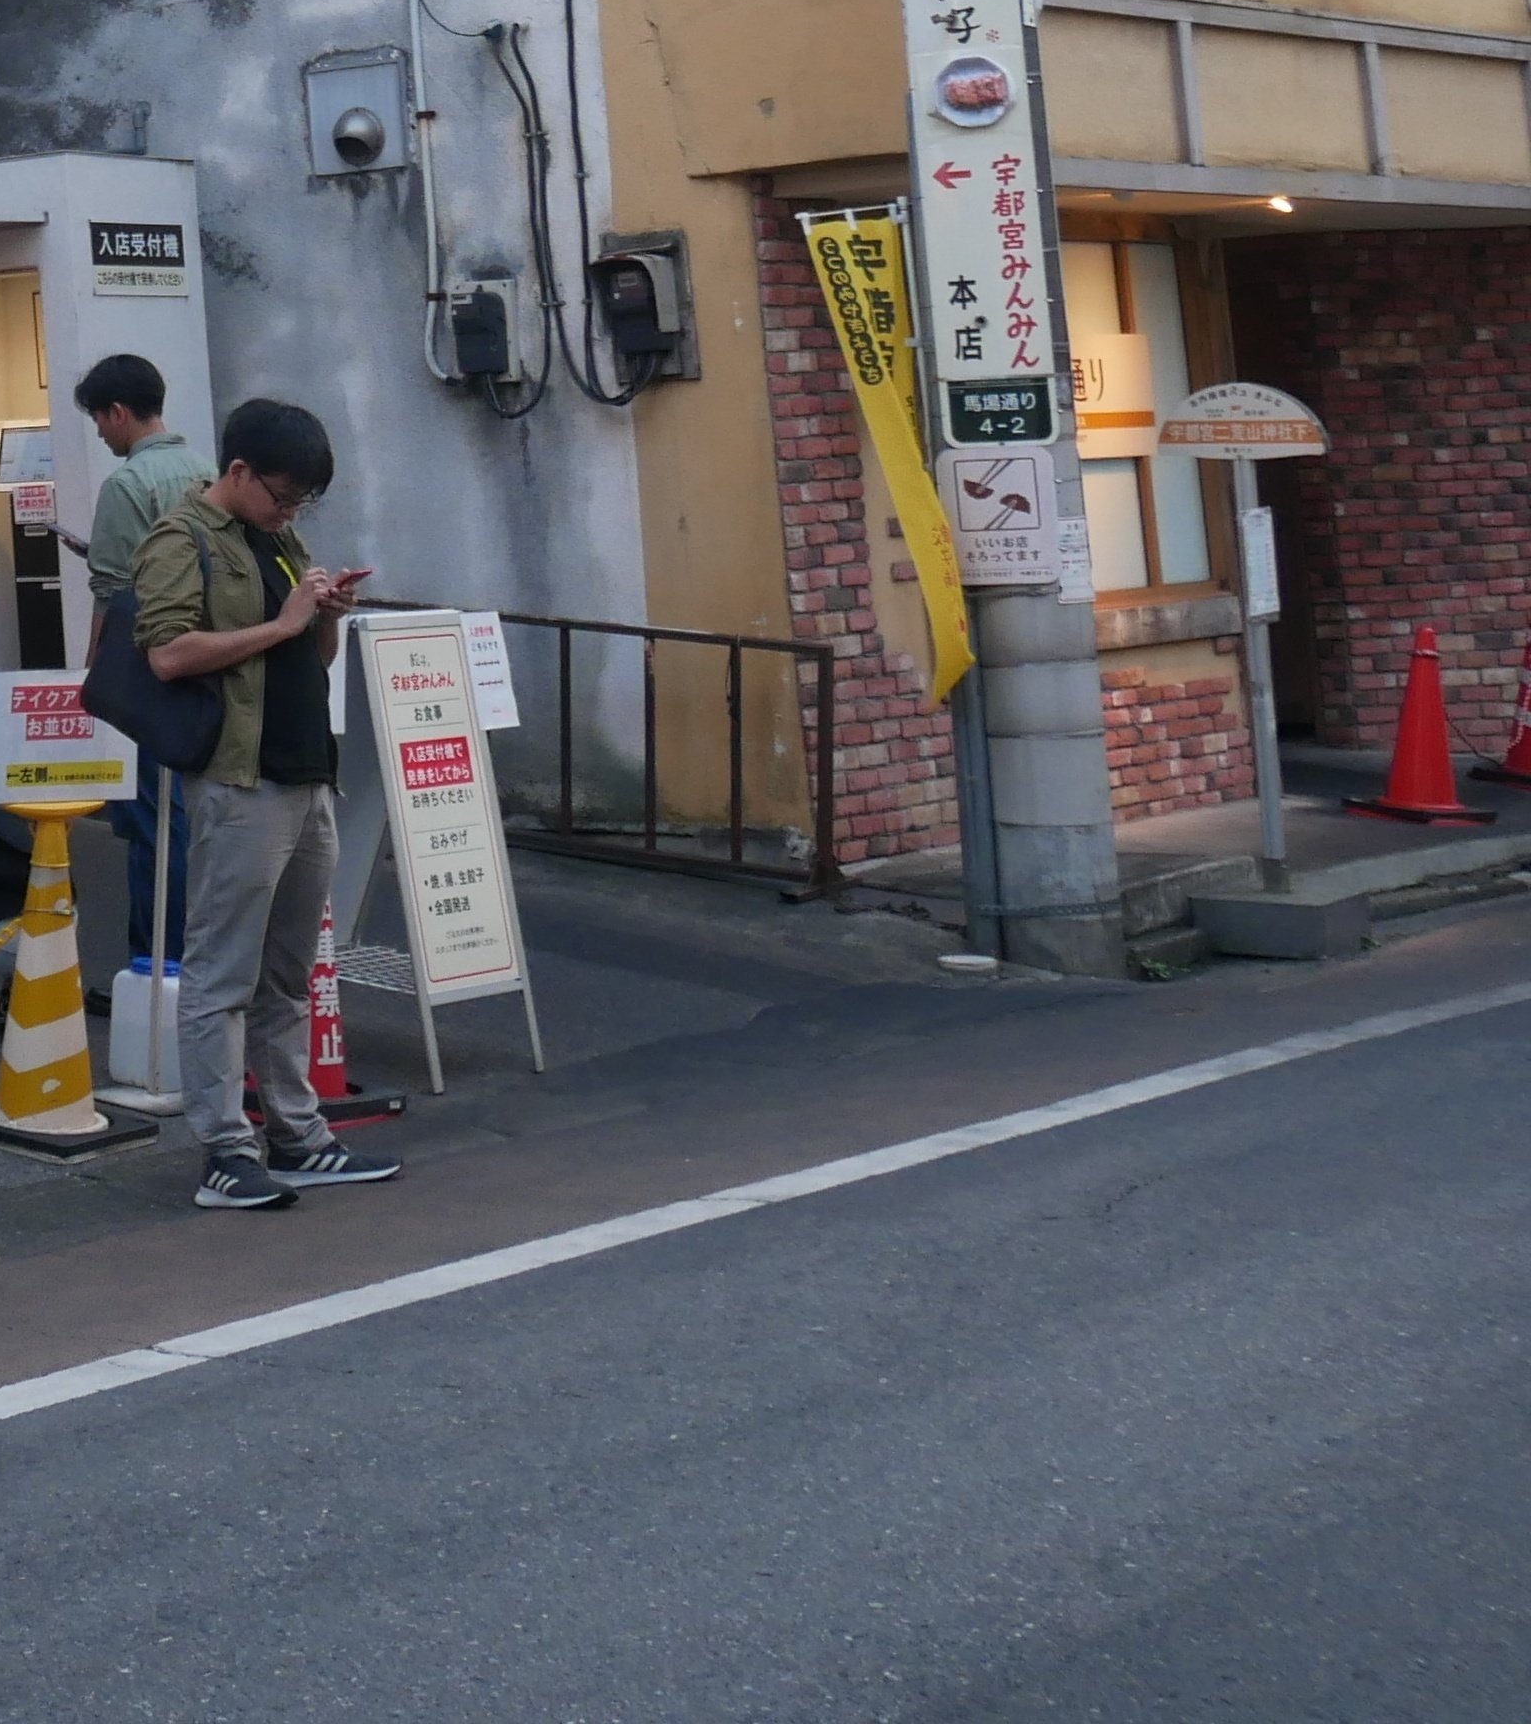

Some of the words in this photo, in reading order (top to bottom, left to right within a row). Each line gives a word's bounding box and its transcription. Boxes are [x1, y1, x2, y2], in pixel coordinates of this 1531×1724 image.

[99, 231, 179, 258] 入店受付機
[992, 153, 1040, 369] 宇都宮みんみん
[947, 274, 983, 361] 本店
[964, 392, 1036, 412] 馬場通り
[979, 417, 1027, 434] 4-2
[975, 535, 1029, 549] いいお店
[965, 549, 1041, 562] そろってます
[390, 671, 456, 692] 宇都宮みんみん
[414, 705, 443, 722] お食事
[28, 716, 94, 736] お並び列
[406, 743, 463, 763] 入店受付機で
[406, 764, 470, 786] 発券をしてから
[411, 789, 474, 809] お待ちください
[430, 830, 469, 850] おみやげ
[313, 894, 344, 1066] 車禁止
